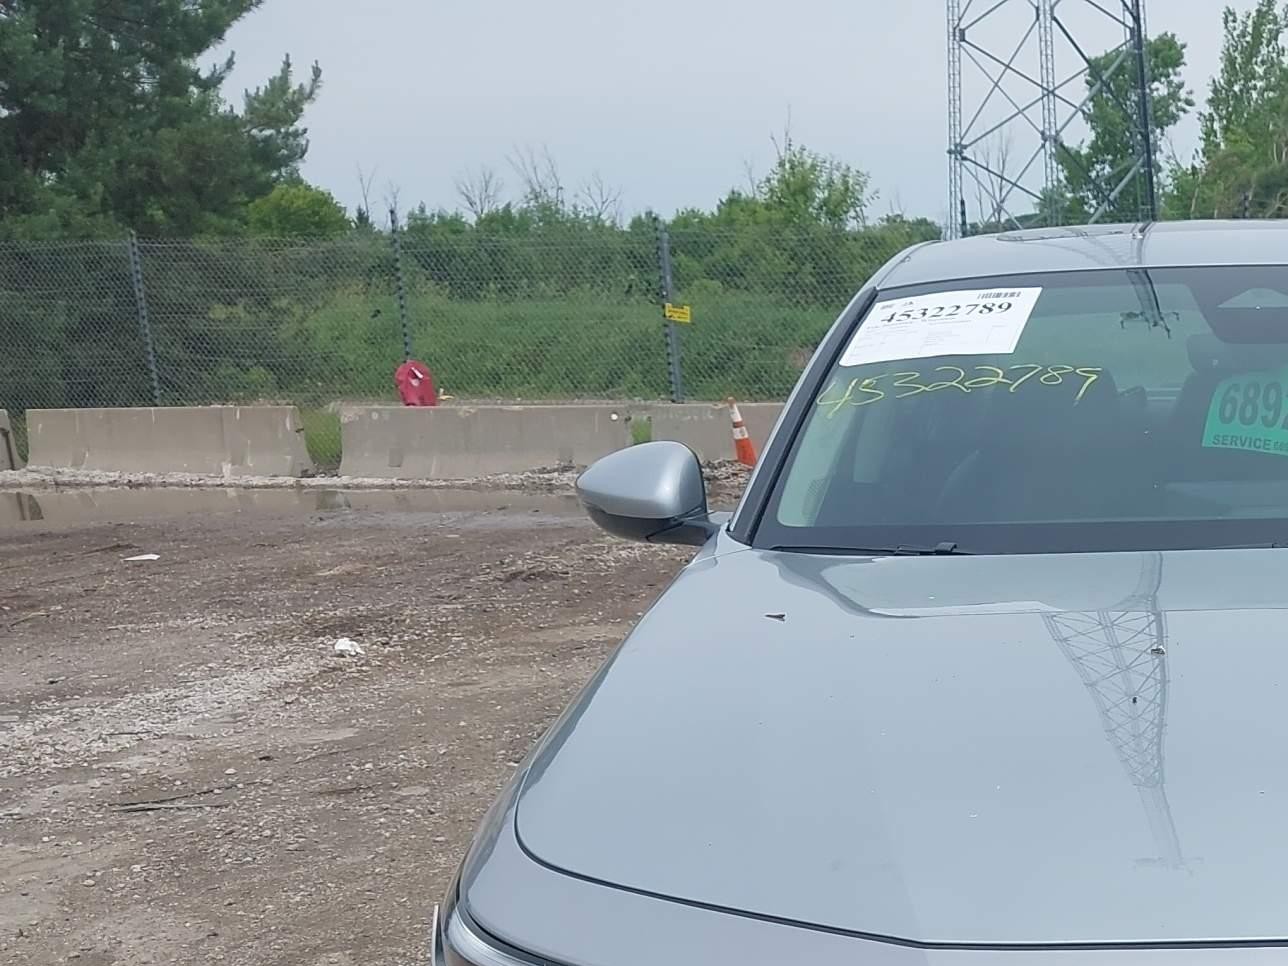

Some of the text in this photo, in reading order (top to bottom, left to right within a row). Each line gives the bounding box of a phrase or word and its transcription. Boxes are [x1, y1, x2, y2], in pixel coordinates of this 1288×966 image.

[881, 301, 1013, 324] 45322789
[815, 364, 1103, 419] 45322789
[1211, 434, 1272, 451] SERVICE
